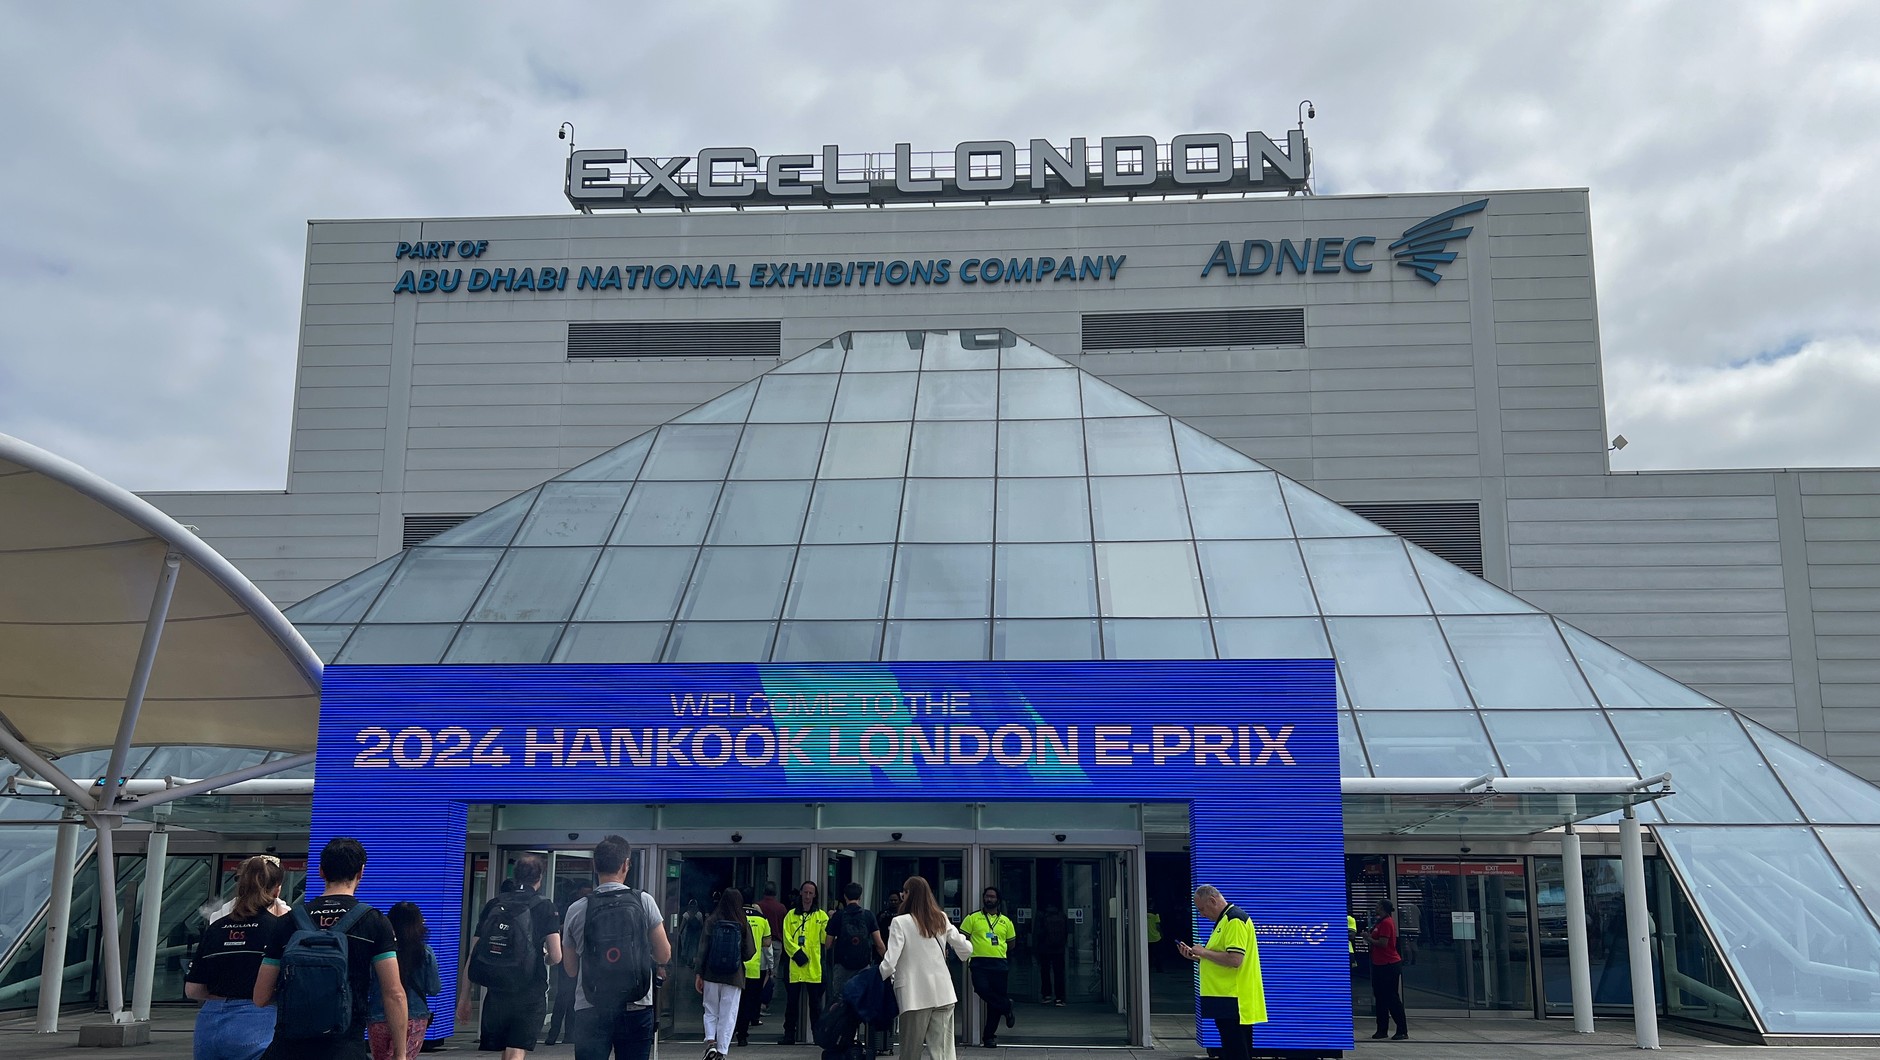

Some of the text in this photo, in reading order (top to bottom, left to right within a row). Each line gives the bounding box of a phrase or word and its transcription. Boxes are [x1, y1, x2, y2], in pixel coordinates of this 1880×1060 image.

[895, 129, 1305, 193] LONDON
[395, 240, 489, 259] PART OF
[1201, 235, 1376, 277] ADNEC
[393, 254, 1127, 294] ABU DHABI NATIONAL EXHIBITIONS COMPANY
[670, 691, 971, 718] WELCOME TO THE
[354, 724, 1297, 769] 2024 HANKOOK LONDON E-PRIX
